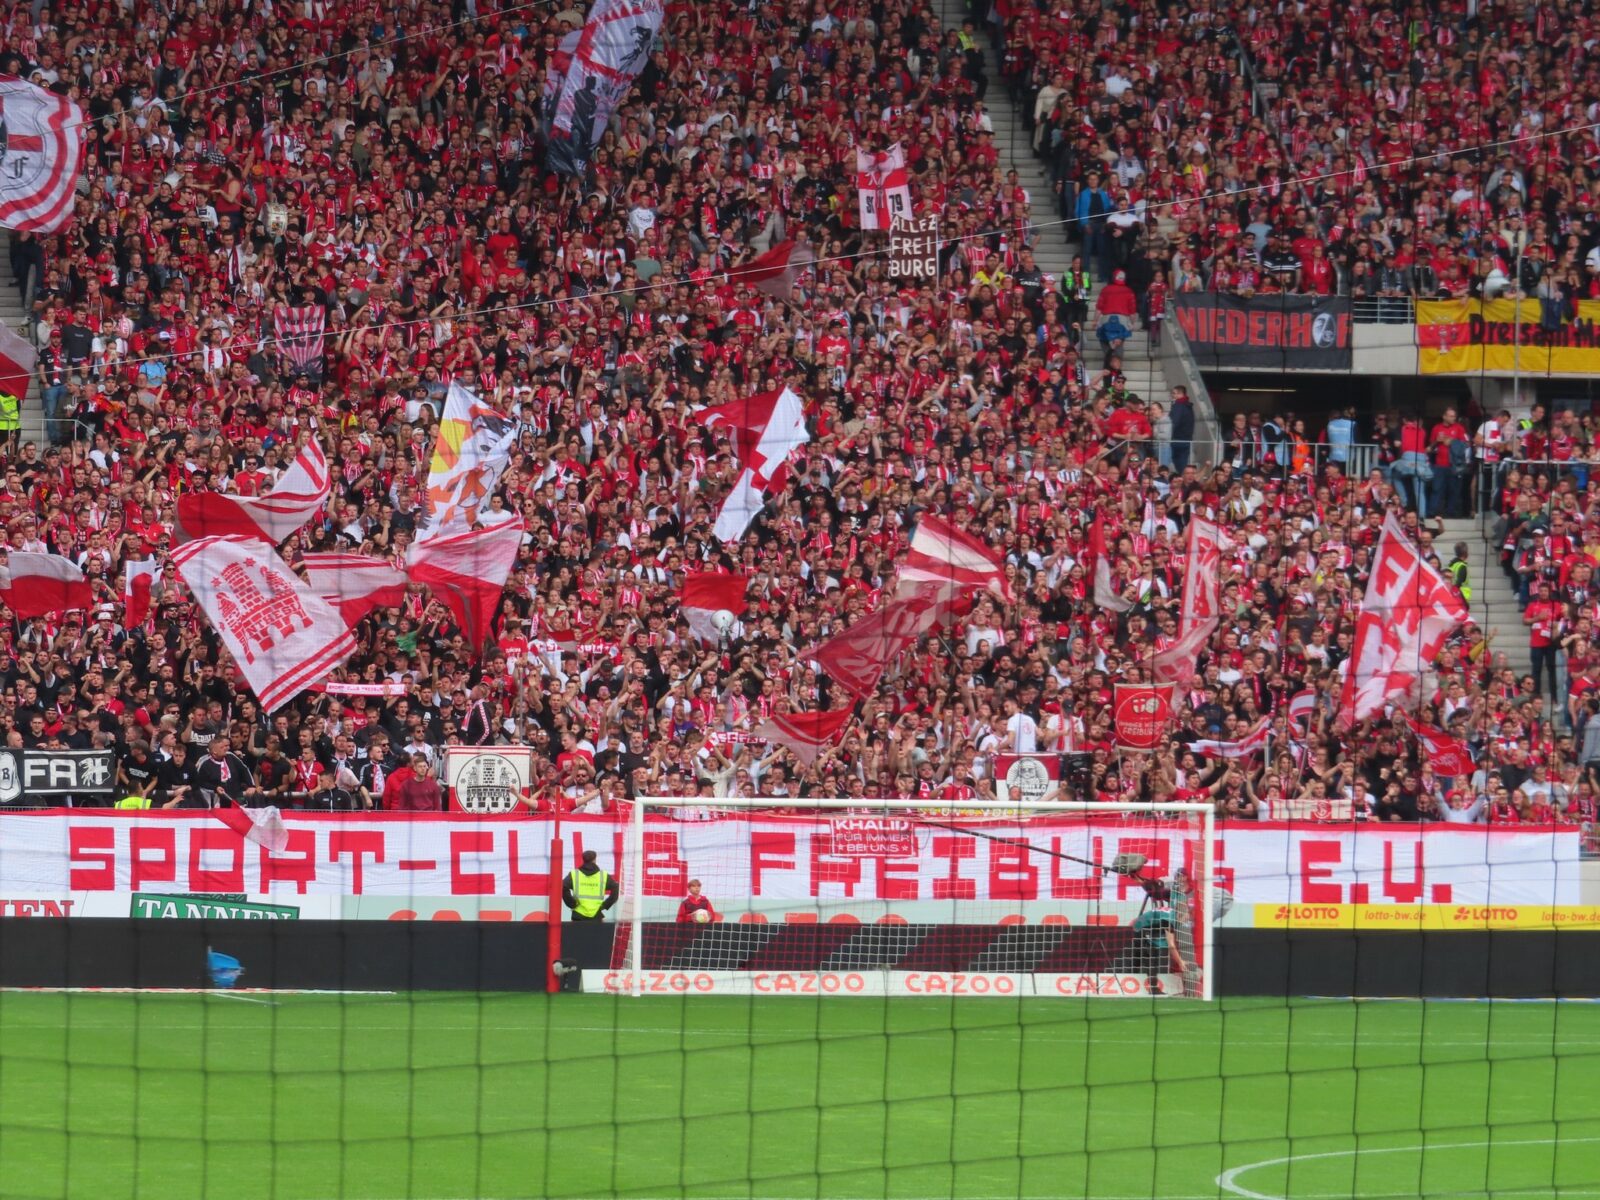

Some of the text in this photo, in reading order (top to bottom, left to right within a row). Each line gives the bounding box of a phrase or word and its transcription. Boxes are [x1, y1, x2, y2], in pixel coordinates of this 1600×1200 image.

[891, 214, 937, 233] ALLEZ
[891, 236, 932, 255] FREI
[890, 258, 936, 277] BURG
[835, 820, 909, 830] KHALID
[866, 833, 910, 843] IMMER
[870, 843, 899, 853] UNS
[1294, 907, 1340, 920] LOTTO
[1472, 908, 1518, 921] LOTTO
[753, 973, 866, 993] CAZOO
[904, 973, 1015, 994] CAZOO
